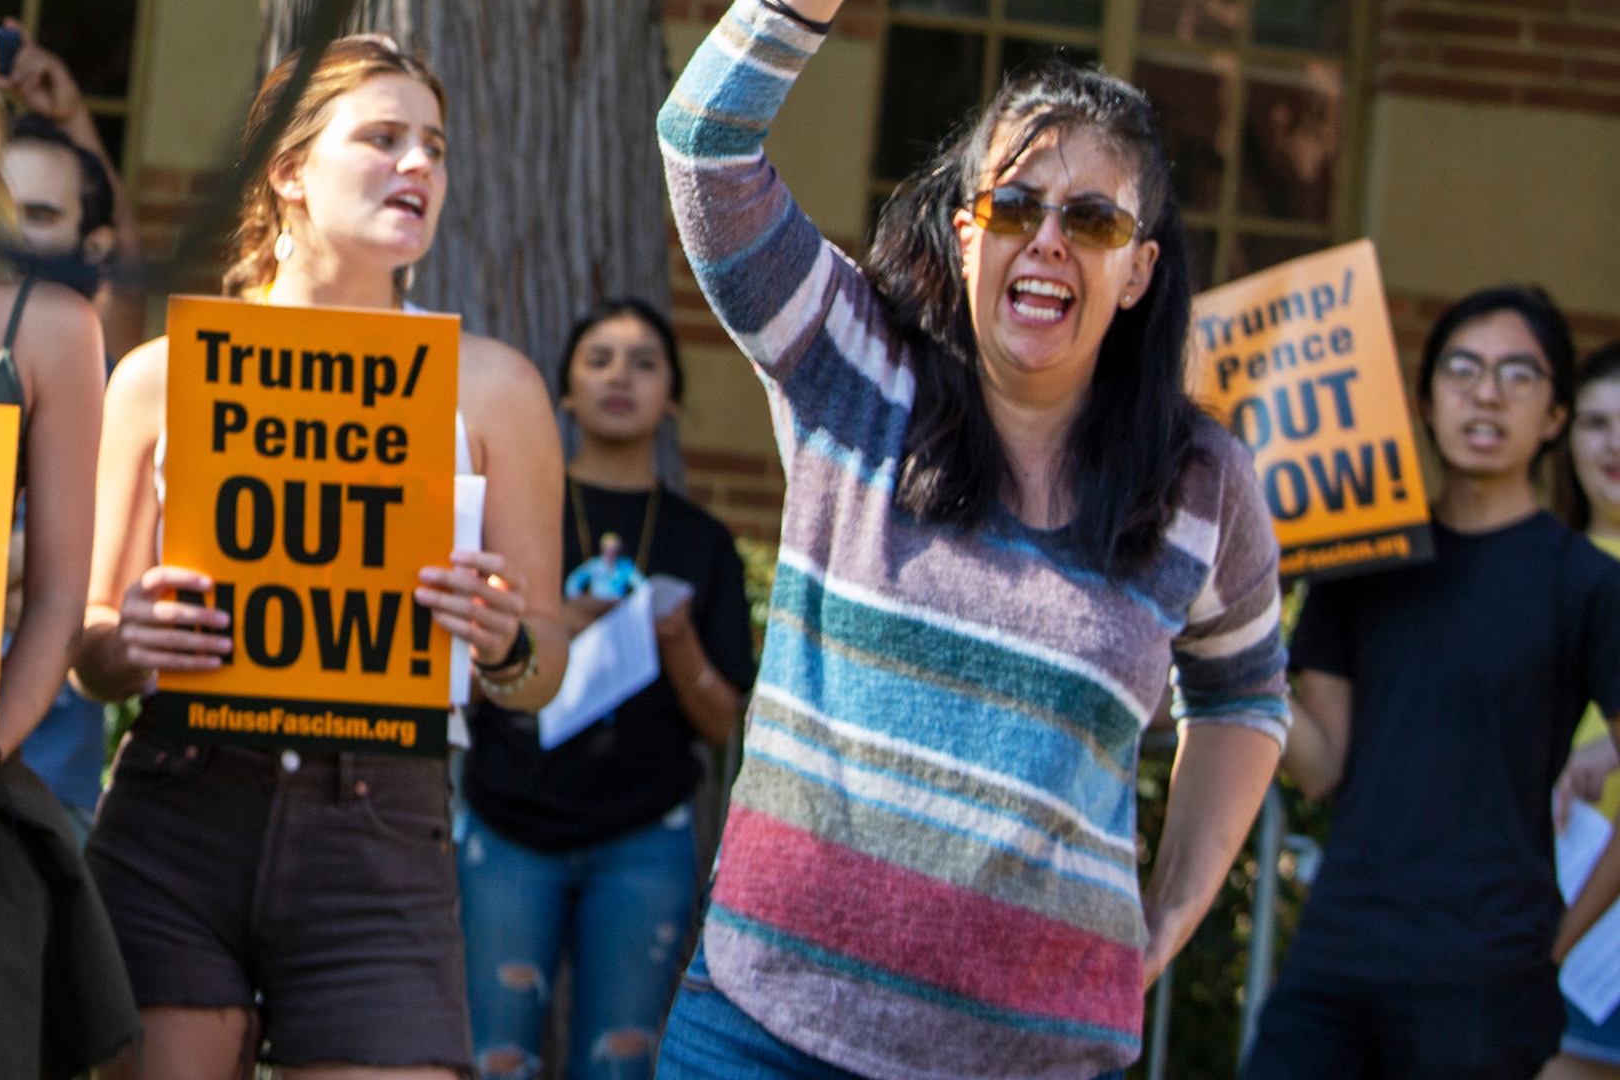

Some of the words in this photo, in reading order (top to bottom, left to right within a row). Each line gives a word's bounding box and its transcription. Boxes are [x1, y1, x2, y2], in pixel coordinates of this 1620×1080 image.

[1196, 268, 1354, 350] Trump/
[196, 330, 430, 407] Trump/
[1217, 326, 1354, 392] Pence
[212, 400, 409, 464] Pence
[1233, 367, 1359, 451] OUT
[1264, 437, 1407, 521] OW!
[215, 475, 404, 569] OUT
[188, 703, 417, 748] RefuseFascism.org
